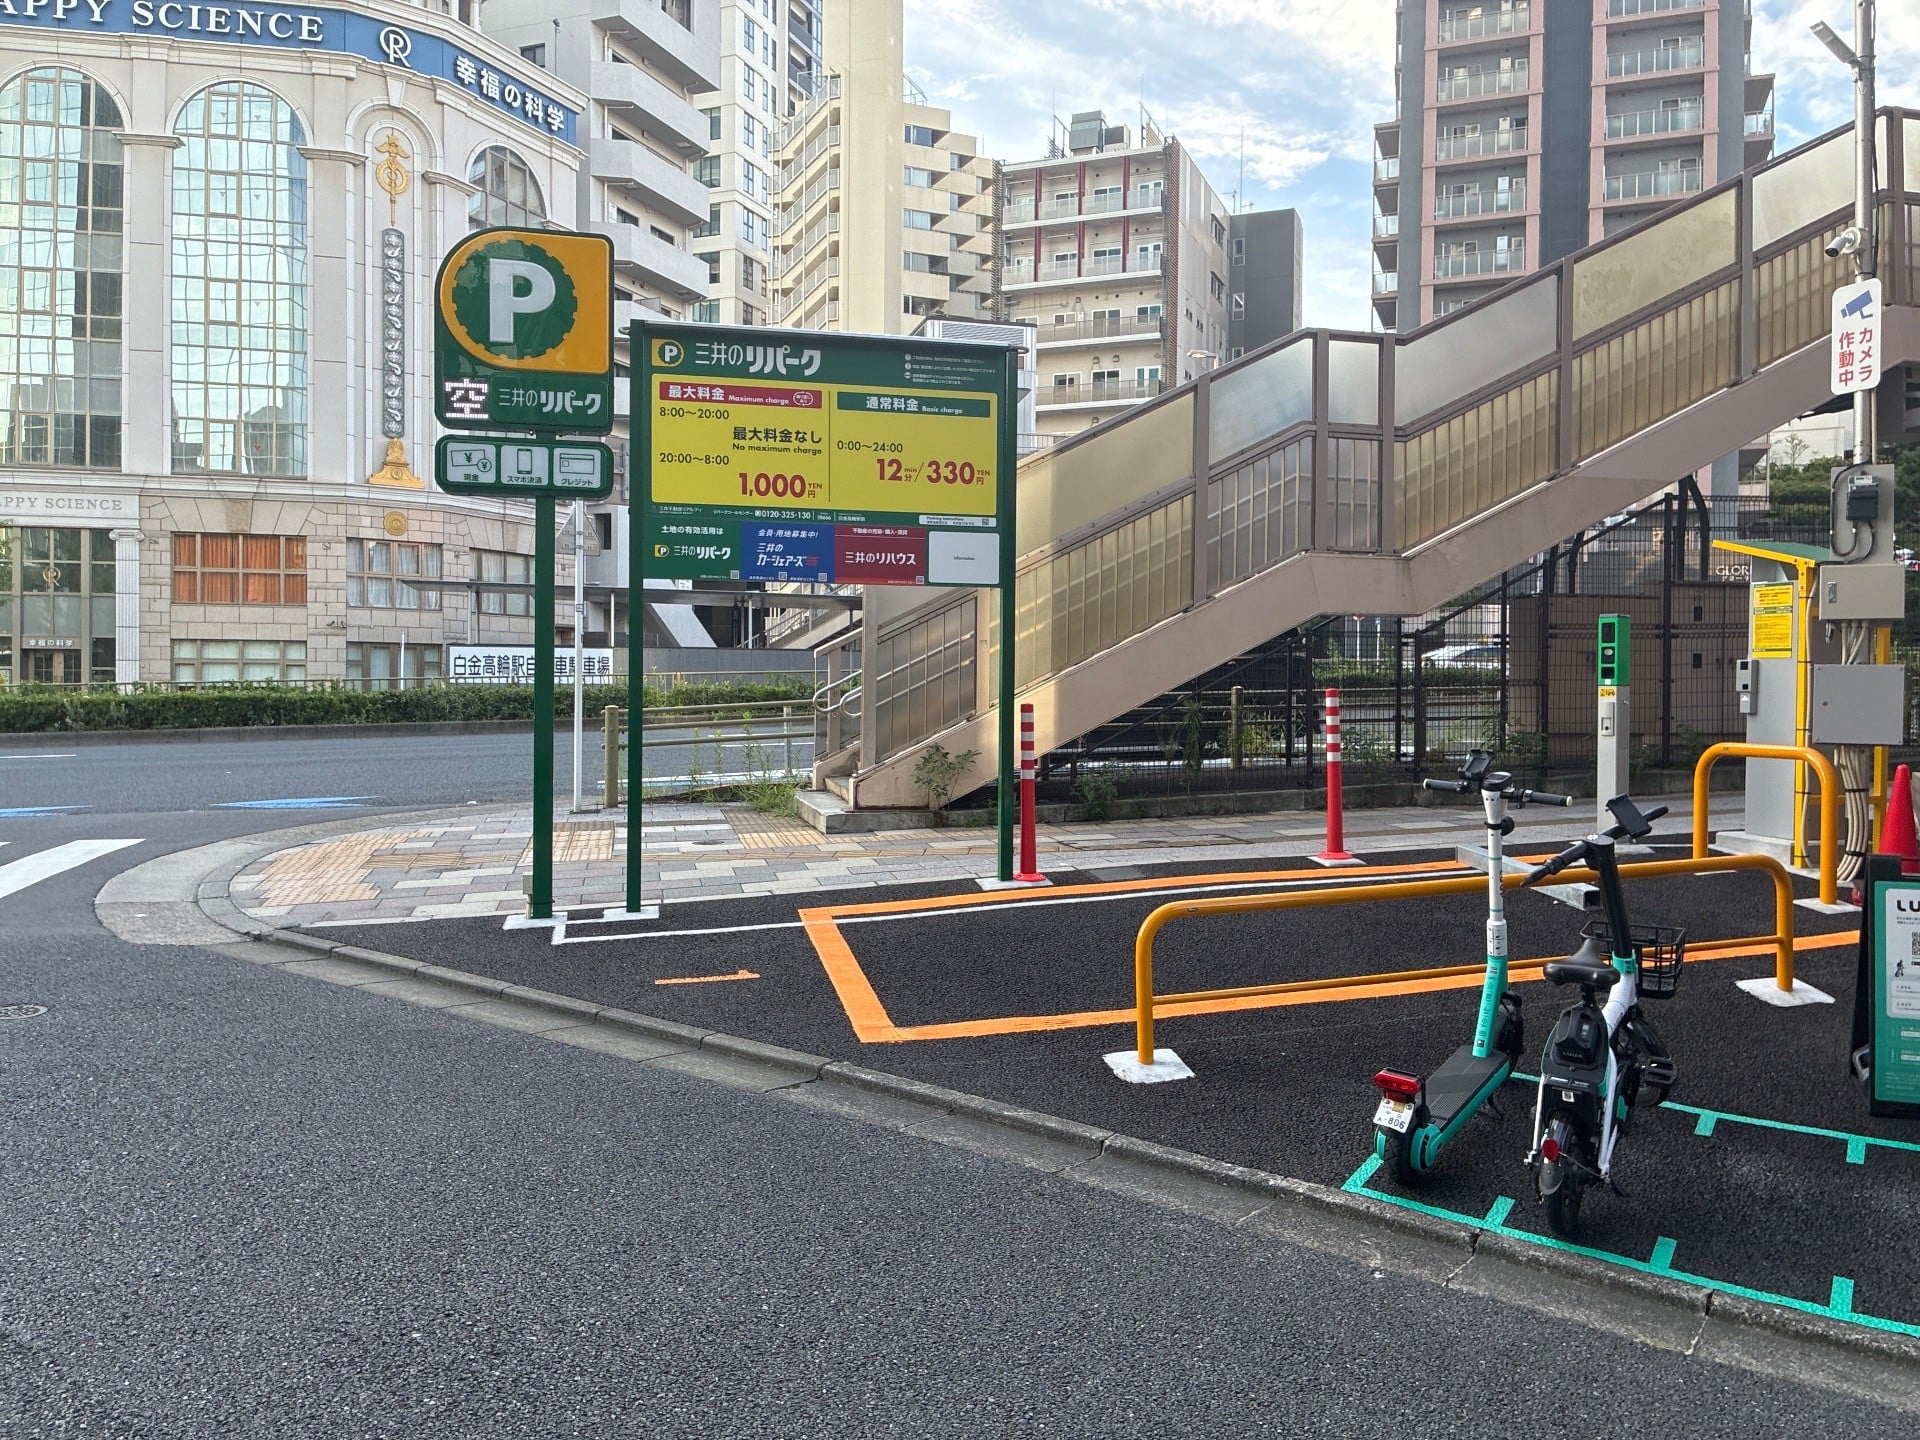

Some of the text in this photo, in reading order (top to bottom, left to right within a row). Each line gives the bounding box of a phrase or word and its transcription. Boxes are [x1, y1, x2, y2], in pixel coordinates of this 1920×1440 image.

[132, 0, 324, 42] SCIENCE
[456, 55, 565, 132] 幸福の科学
[489, 257, 556, 344] P
[695, 342, 822, 376] 三井のリパーク
[1838, 331, 1854, 386] 作動中
[1859, 327, 1873, 382] カメラ
[445, 378, 488, 419] 空
[668, 385, 725, 401] 最大料金
[728, 394, 789, 405] Maximum charge
[498, 388, 601, 415] 三井のリパーク
[866, 396, 919, 411] 通常料金
[921, 405, 963, 415] Basic charge
[732, 427, 822, 444] 最大料金なし
[732, 443, 822, 456] No maximum charge
[463, 473, 479, 482] 現金
[876, 458, 902, 481] 12
[926, 460, 975, 485] 330
[904, 474, 912, 482] 分
[507, 475, 543, 485] スマホ決済
[561, 478, 593, 486] クレジット
[738, 472, 823, 498] 1,000 YEN
[976, 477, 984, 485] 円
[808, 490, 815, 498] 円
[45, 498, 122, 510] SCIENCE
[761, 510, 811, 520] 0120-325-130
[661, 526, 724, 535] 土地の有効活用は
[673, 545, 731, 560] 三井のリパーク
[757, 543, 783, 553] 三井の
[844, 551, 916, 565] 三井のリハウス
[1388, 1117, 1406, 1129] 806
